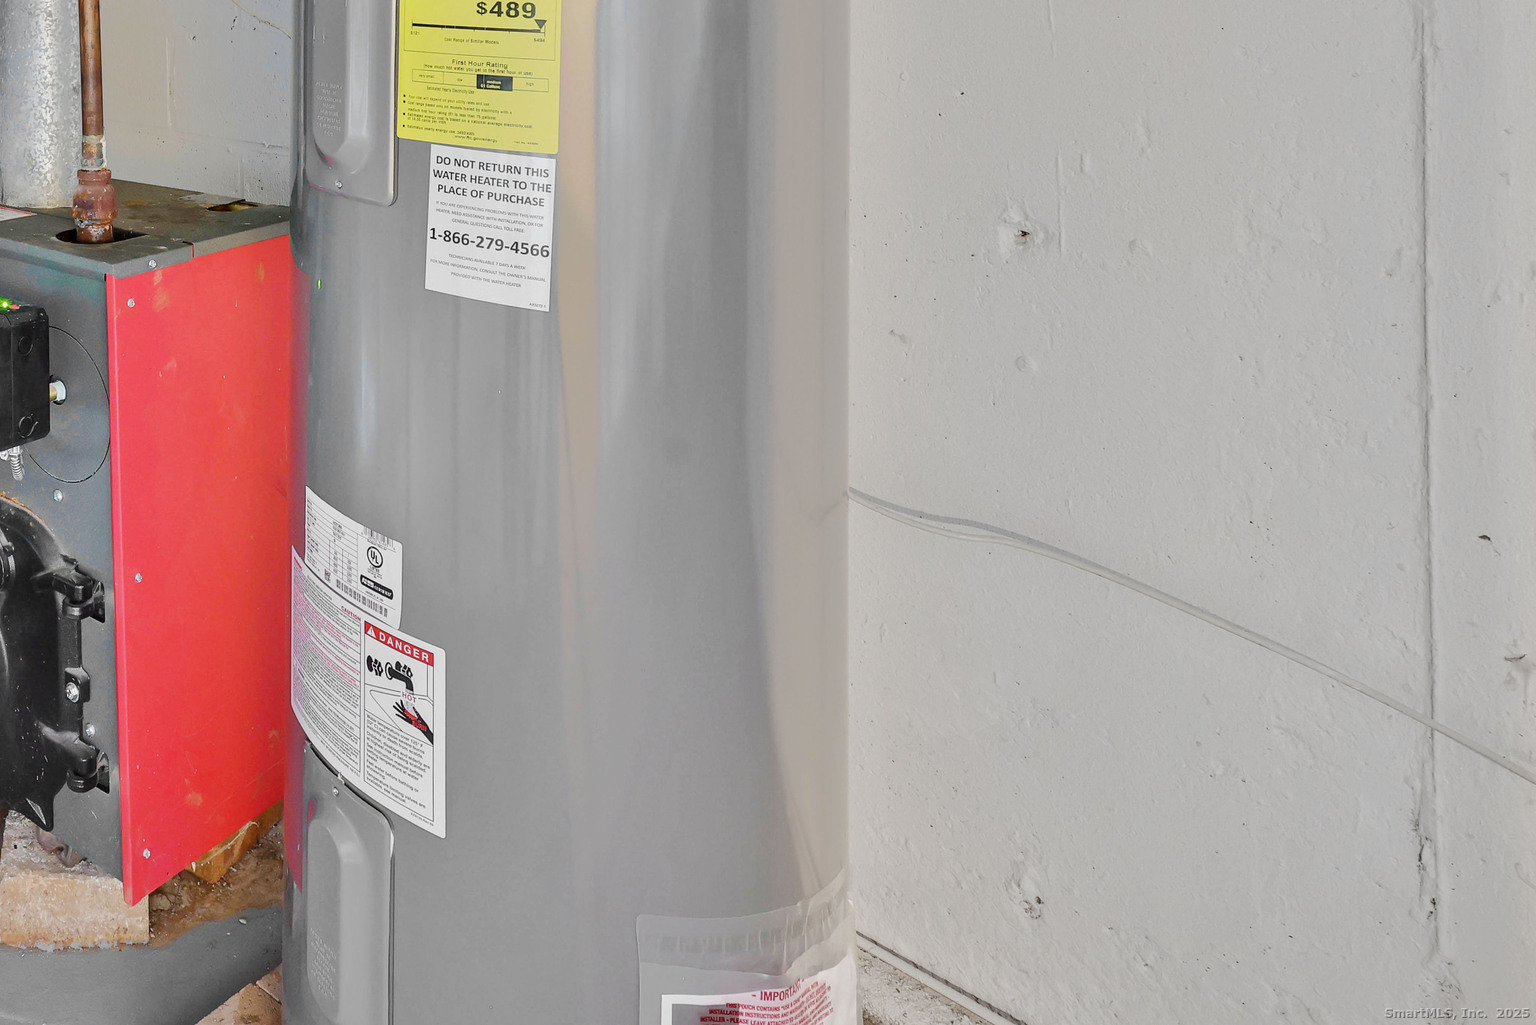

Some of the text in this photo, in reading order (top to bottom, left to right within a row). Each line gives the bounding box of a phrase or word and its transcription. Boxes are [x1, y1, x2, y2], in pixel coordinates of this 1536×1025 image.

[476, 1, 536, 19] $489
[436, 156, 549, 178] DO NOT RETURN THIS
[433, 169, 552, 193] WATER HEATER TO THE
[438, 184, 545, 207] PLACE OF PURCHASE
[430, 227, 550, 258] 1-866-279-4566
[370, 550, 379, 565] UL
[341, 606, 361, 621] CAUTION
[379, 631, 429, 662] DANGER
[402, 692, 416, 703] HOT
[760, 978, 800, 1001] IMPORTANT
